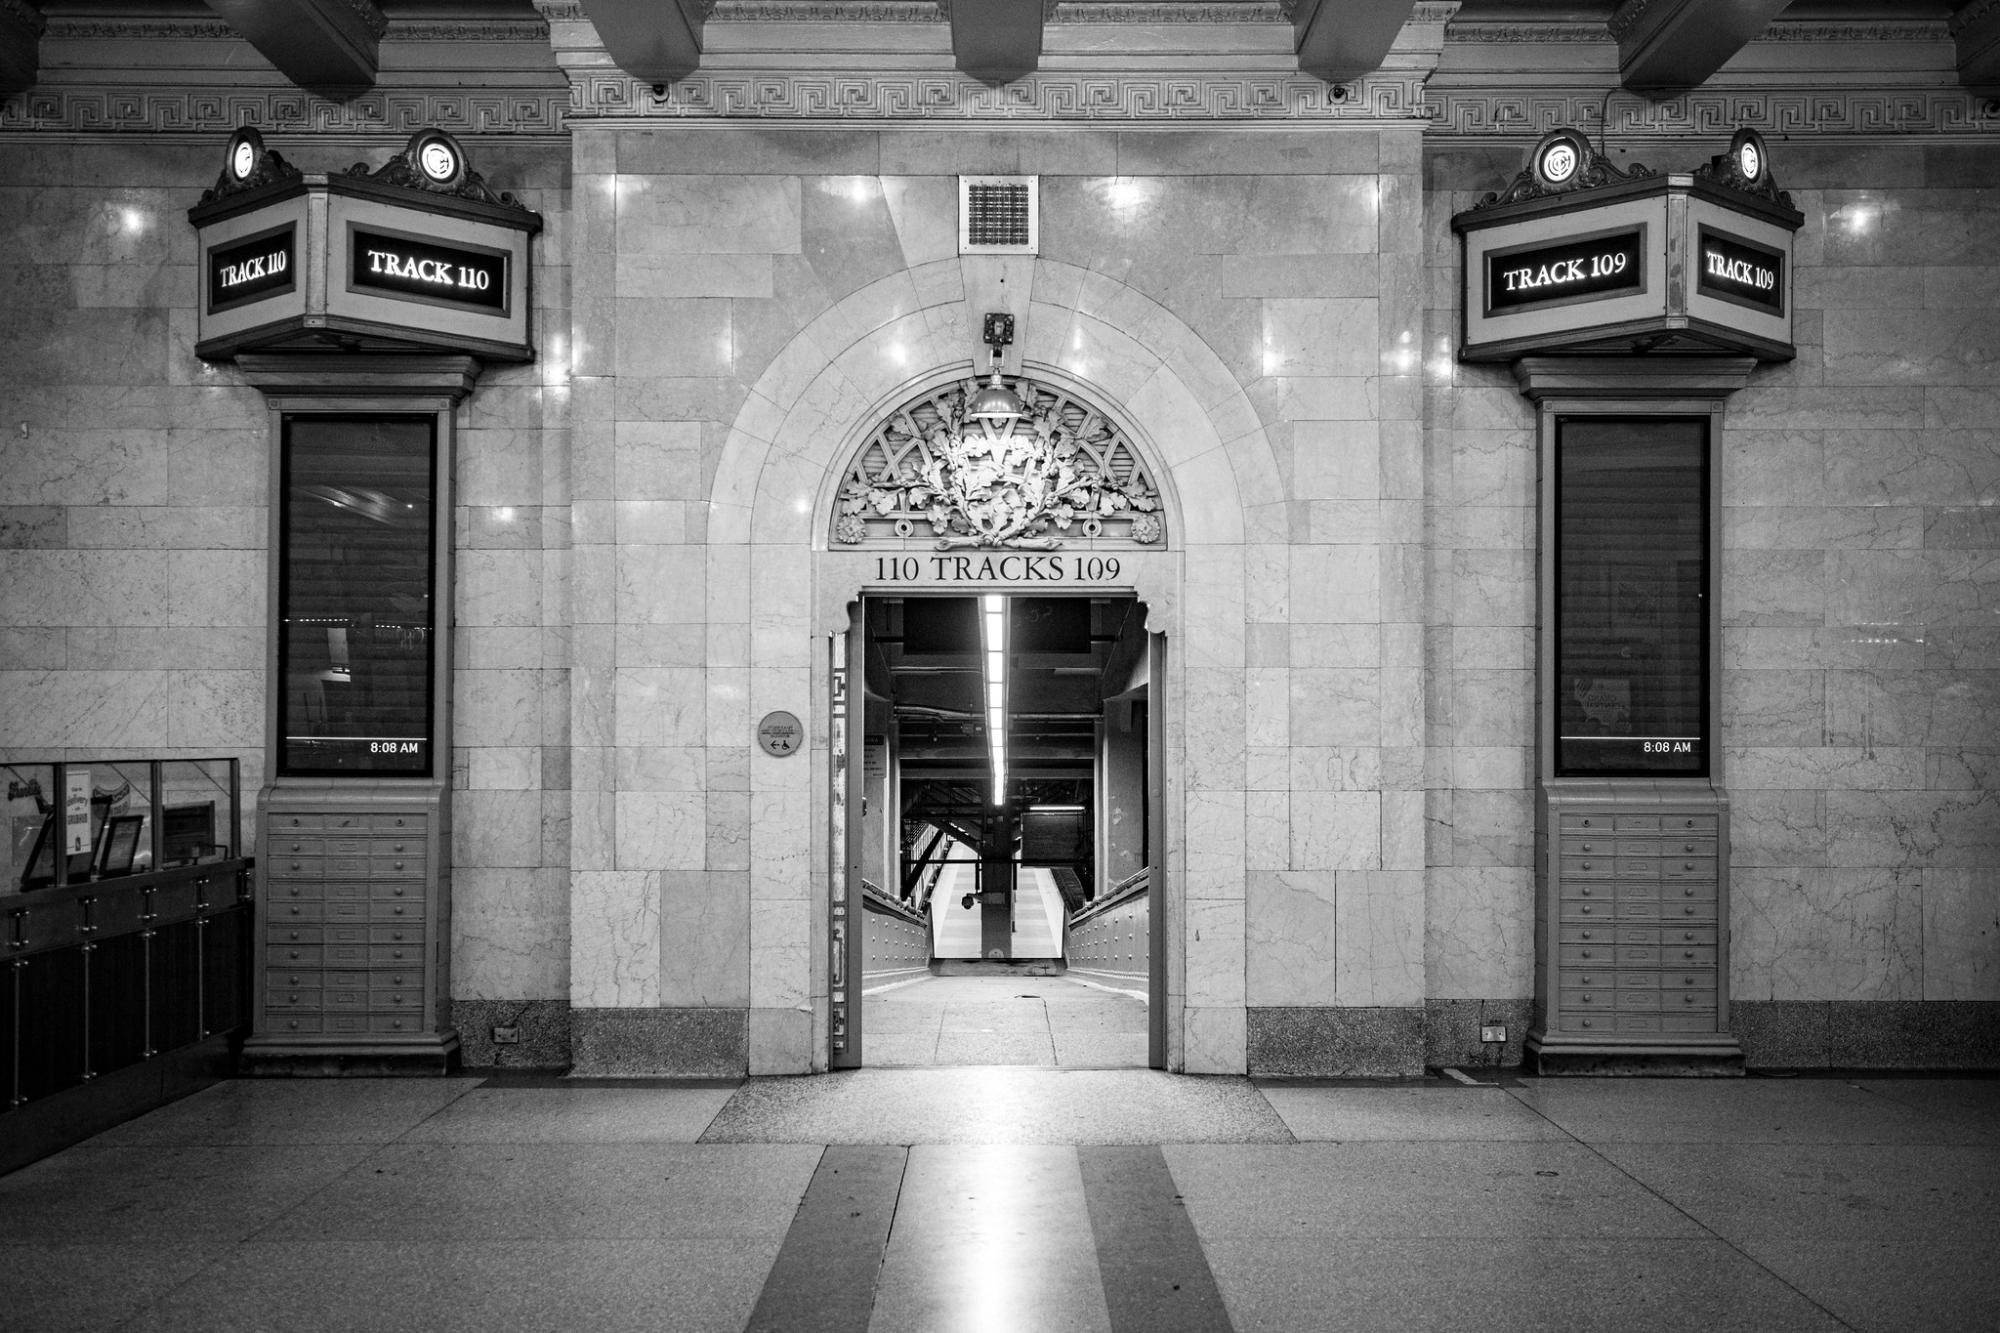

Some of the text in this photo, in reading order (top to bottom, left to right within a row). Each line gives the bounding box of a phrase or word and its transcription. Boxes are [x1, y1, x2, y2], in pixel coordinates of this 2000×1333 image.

[220, 250, 287, 288] TRACK 110
[367, 249, 490, 290] TRACK 110
[1503, 252, 1627, 291] TRACK 109
[1706, 250, 1774, 291] TRACK 109
[875, 556, 1121, 581] 110 TRACKS 109
[370, 741, 418, 753] 8:08 AM
[1643, 741, 1691, 753] 8:08 AM
